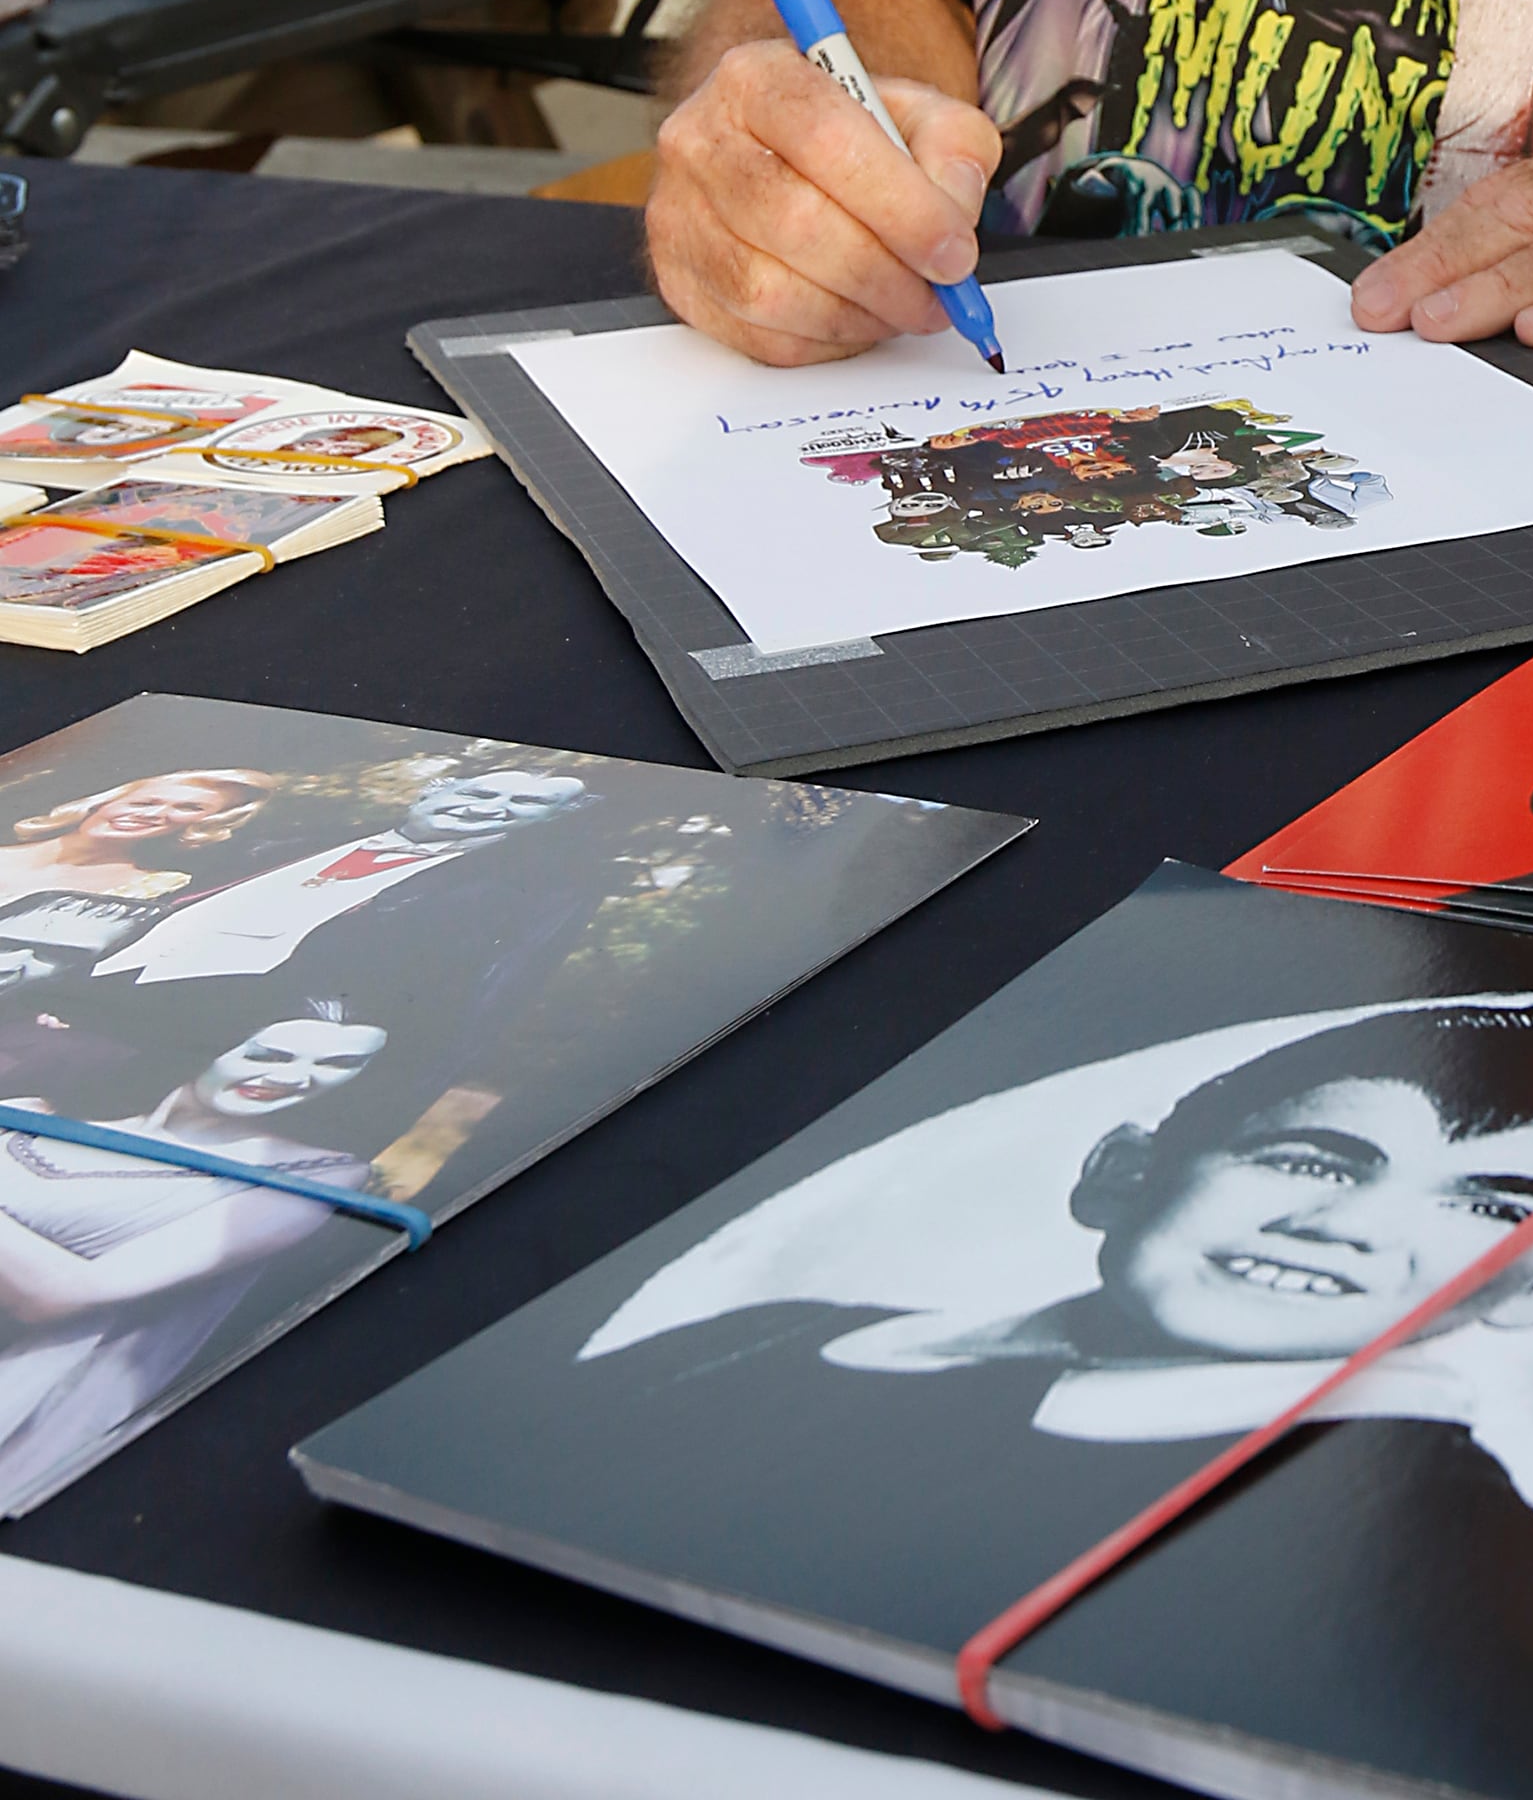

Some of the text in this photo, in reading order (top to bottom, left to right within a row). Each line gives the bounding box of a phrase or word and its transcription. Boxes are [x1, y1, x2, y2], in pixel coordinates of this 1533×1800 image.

[1277, 344, 1317, 359] my
[1082, 367, 1173, 384] Happy
[327, 413, 359, 424] IN
[714, 396, 941, 435] Anniversary
[1042, 439, 1095, 457] 45
